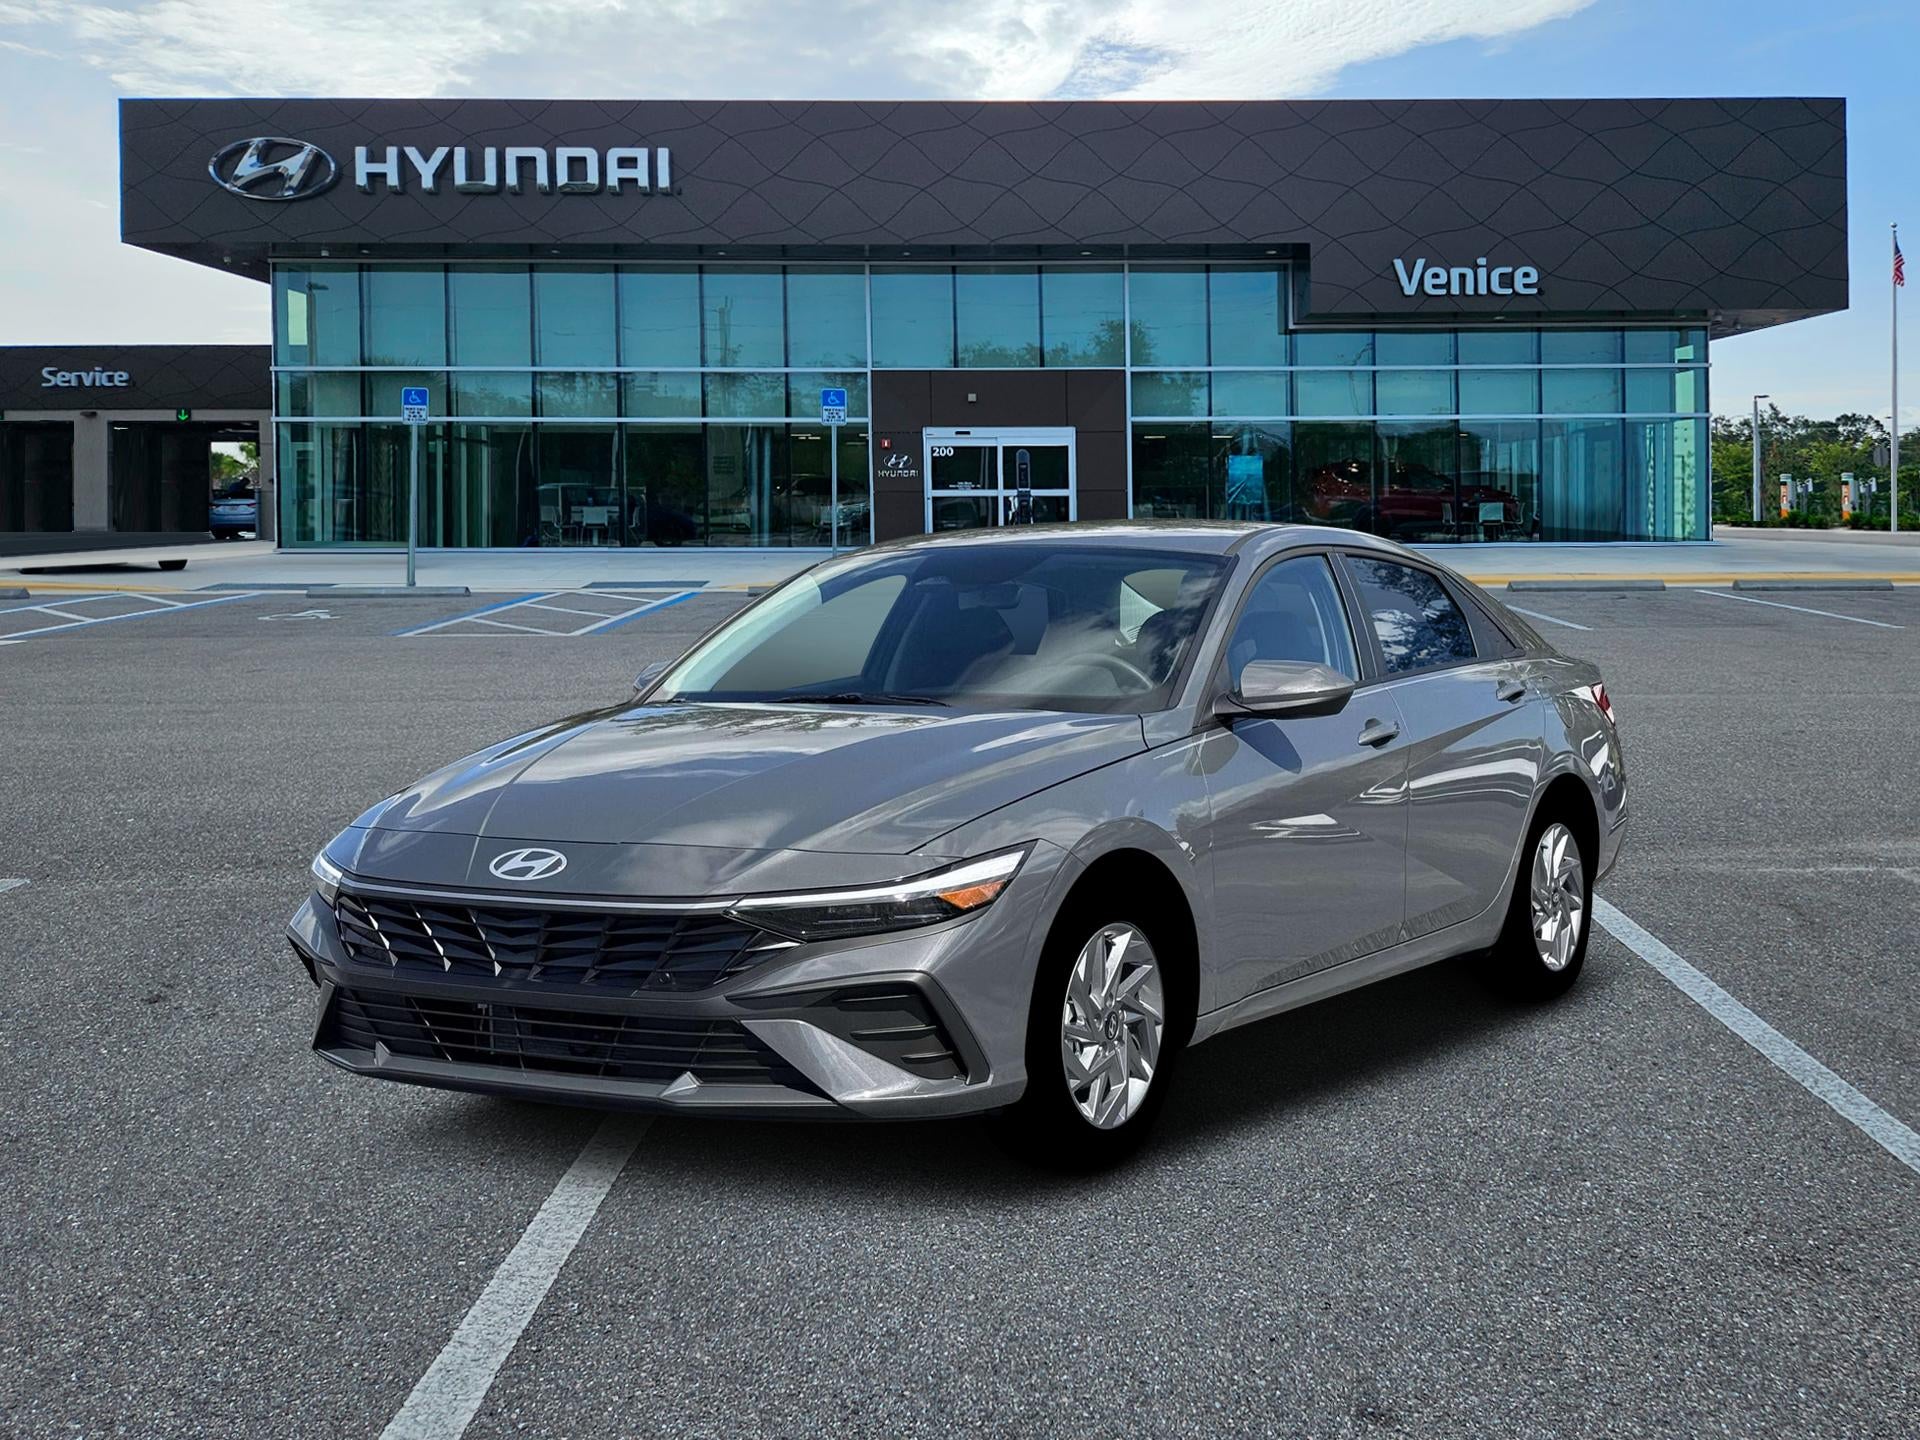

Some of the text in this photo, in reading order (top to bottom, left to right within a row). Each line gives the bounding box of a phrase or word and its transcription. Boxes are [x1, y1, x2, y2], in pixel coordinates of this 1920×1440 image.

[354, 146, 671, 194] HYUNDAI
[1393, 257, 1539, 296] Venice
[41, 366, 130, 387] Service
[933, 447, 955, 457] 200
[878, 470, 919, 478] HYUNDAI
